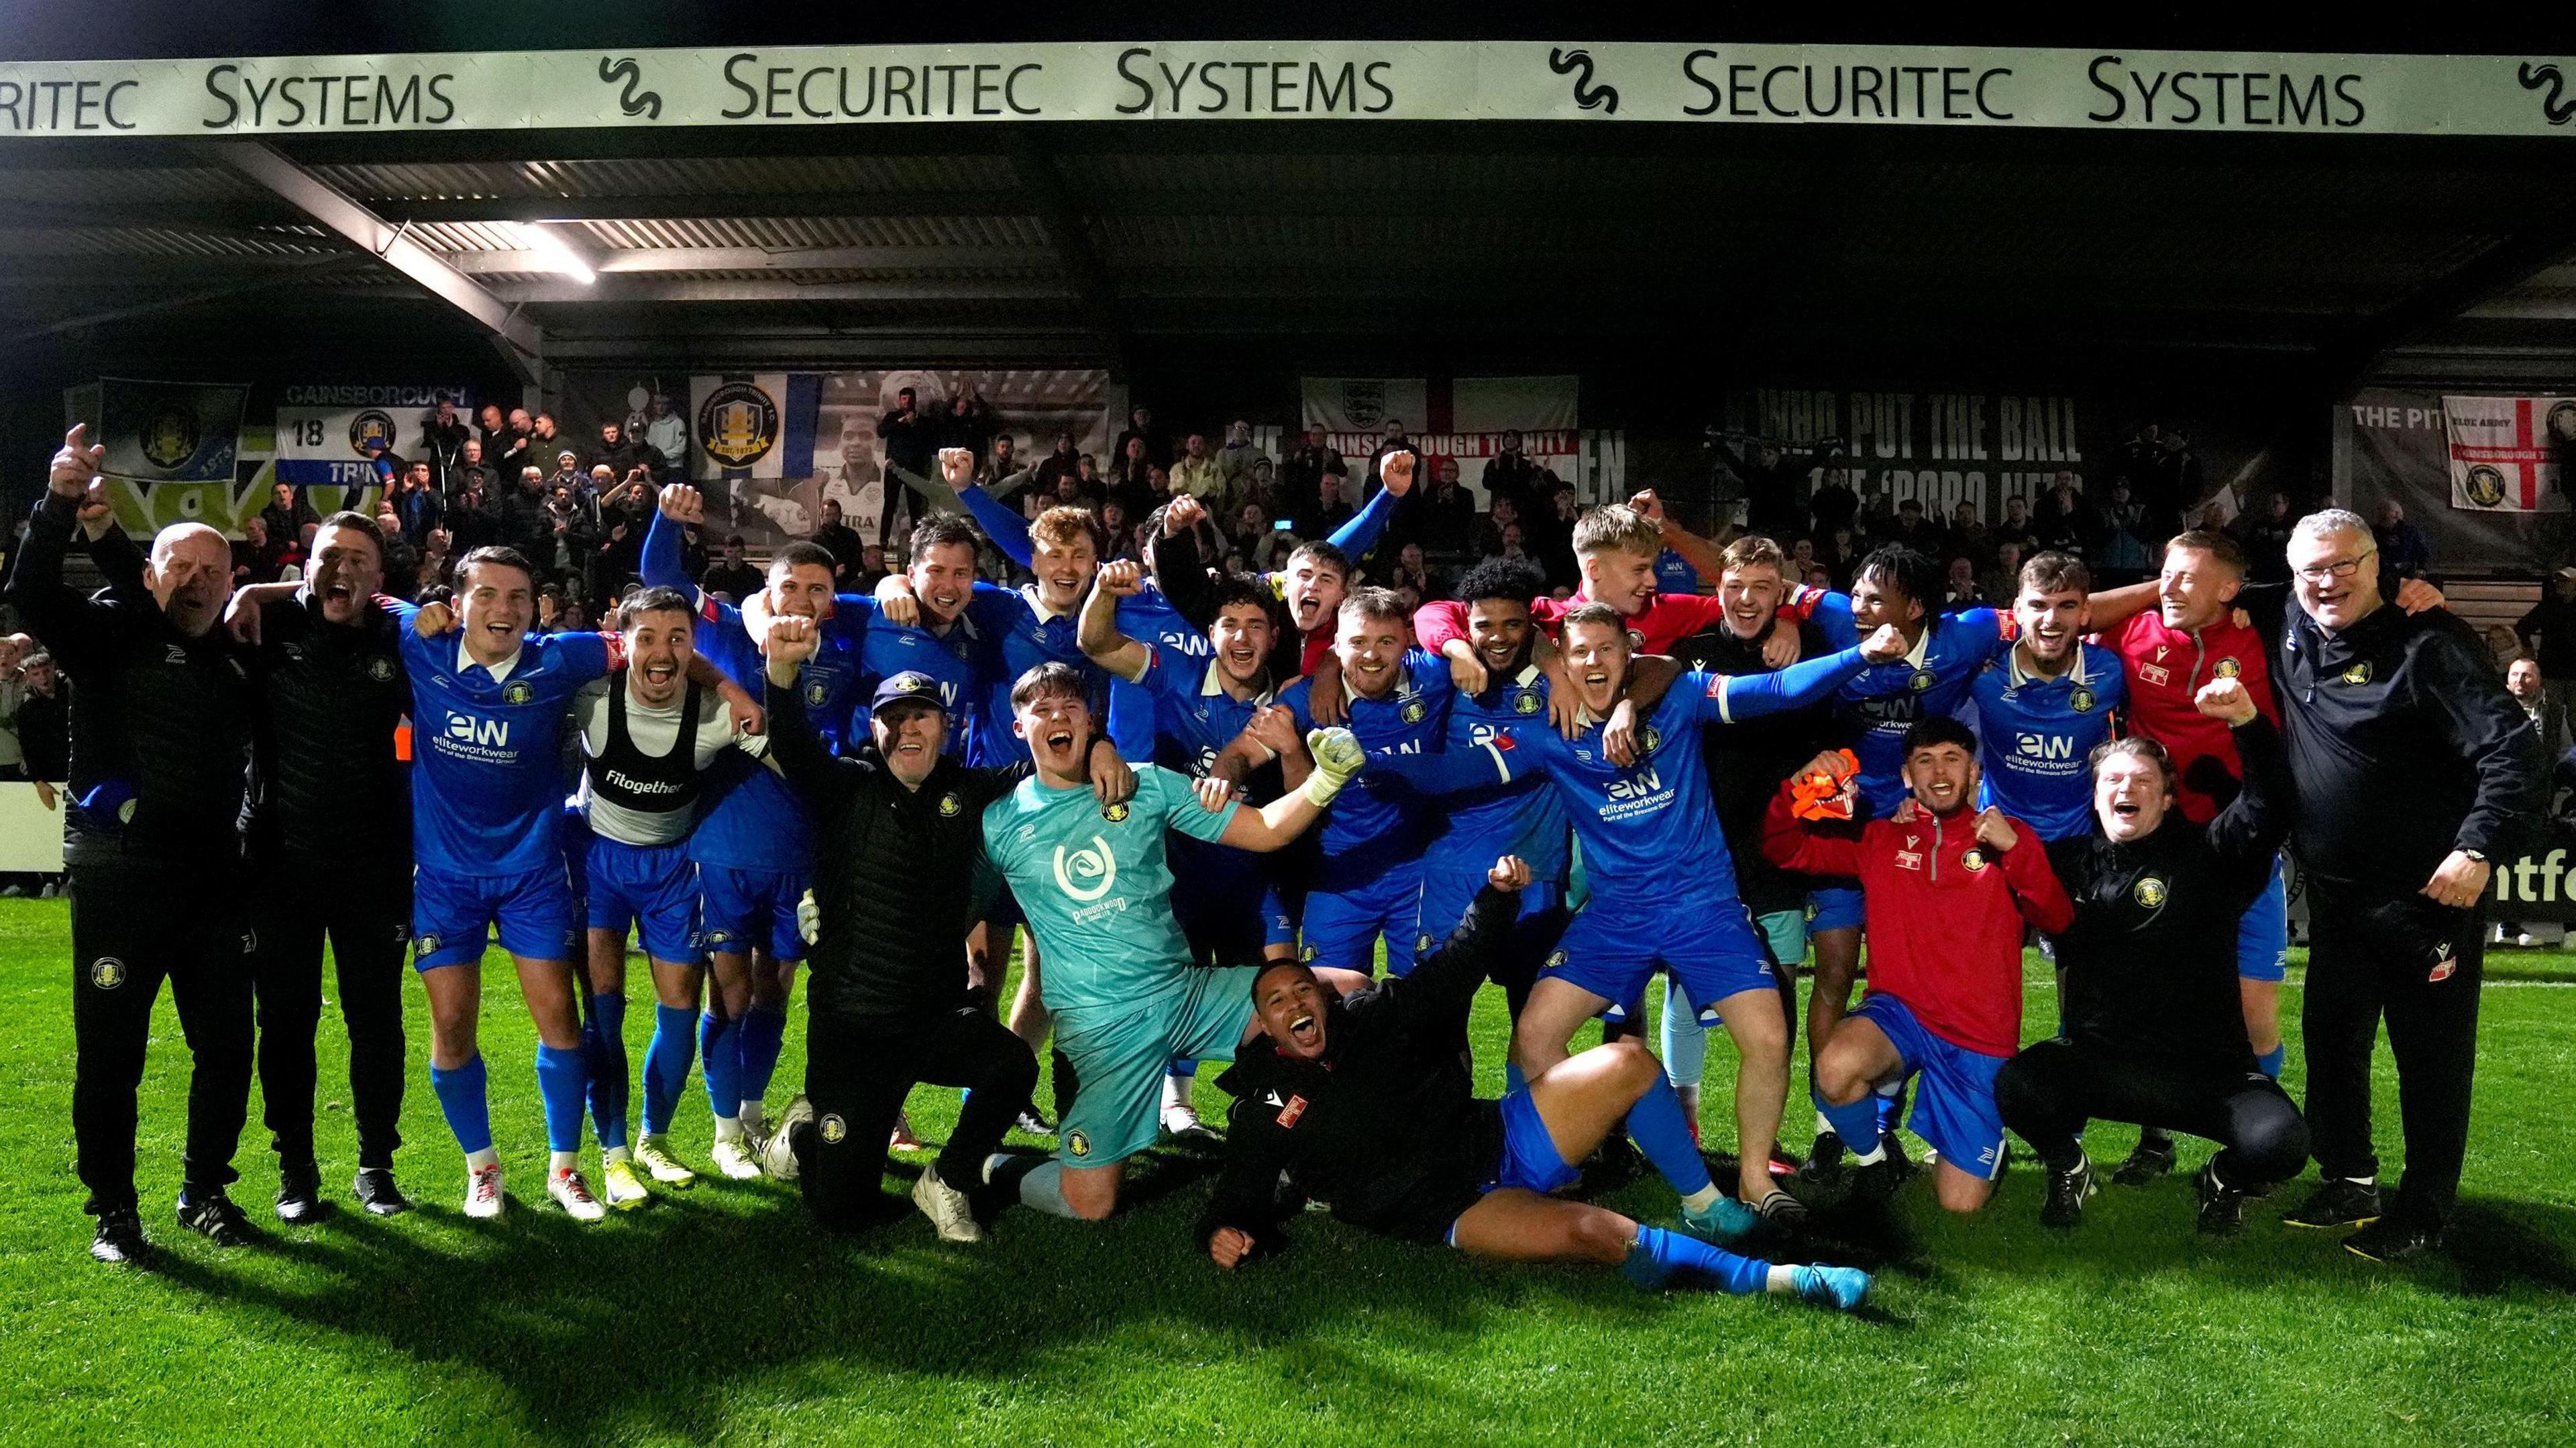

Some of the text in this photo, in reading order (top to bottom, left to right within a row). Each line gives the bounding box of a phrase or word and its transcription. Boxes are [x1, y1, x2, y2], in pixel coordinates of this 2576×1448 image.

[202, 64, 455, 128] SYSTEMS
[720, 48, 1394, 119] SECURITEC SYSTEMS
[1682, 49, 2365, 127] SECURITEC SYSTEMS
[1851, 393, 1915, 459] PUT
[1930, 393, 1988, 461] THE
[2000, 397, 2082, 462] BALL
[2352, 405, 2402, 429] THE
[292, 419, 324, 446] 18
[1484, 431, 1568, 456] TNITY
[328, 460, 380, 484] TRIN
[433, 736, 519, 758] eliteworkwear
[435, 745, 446, 754] Part
[455, 752, 466, 760] the
[2005, 754, 2082, 770] eliteworkwear
[2006, 762, 2018, 771] Part
[606, 769, 684, 794] Fitogether
[1599, 788, 1675, 816] eliteworkwear
[1603, 813, 1615, 822] Part
[1623, 811, 1633, 819] the
